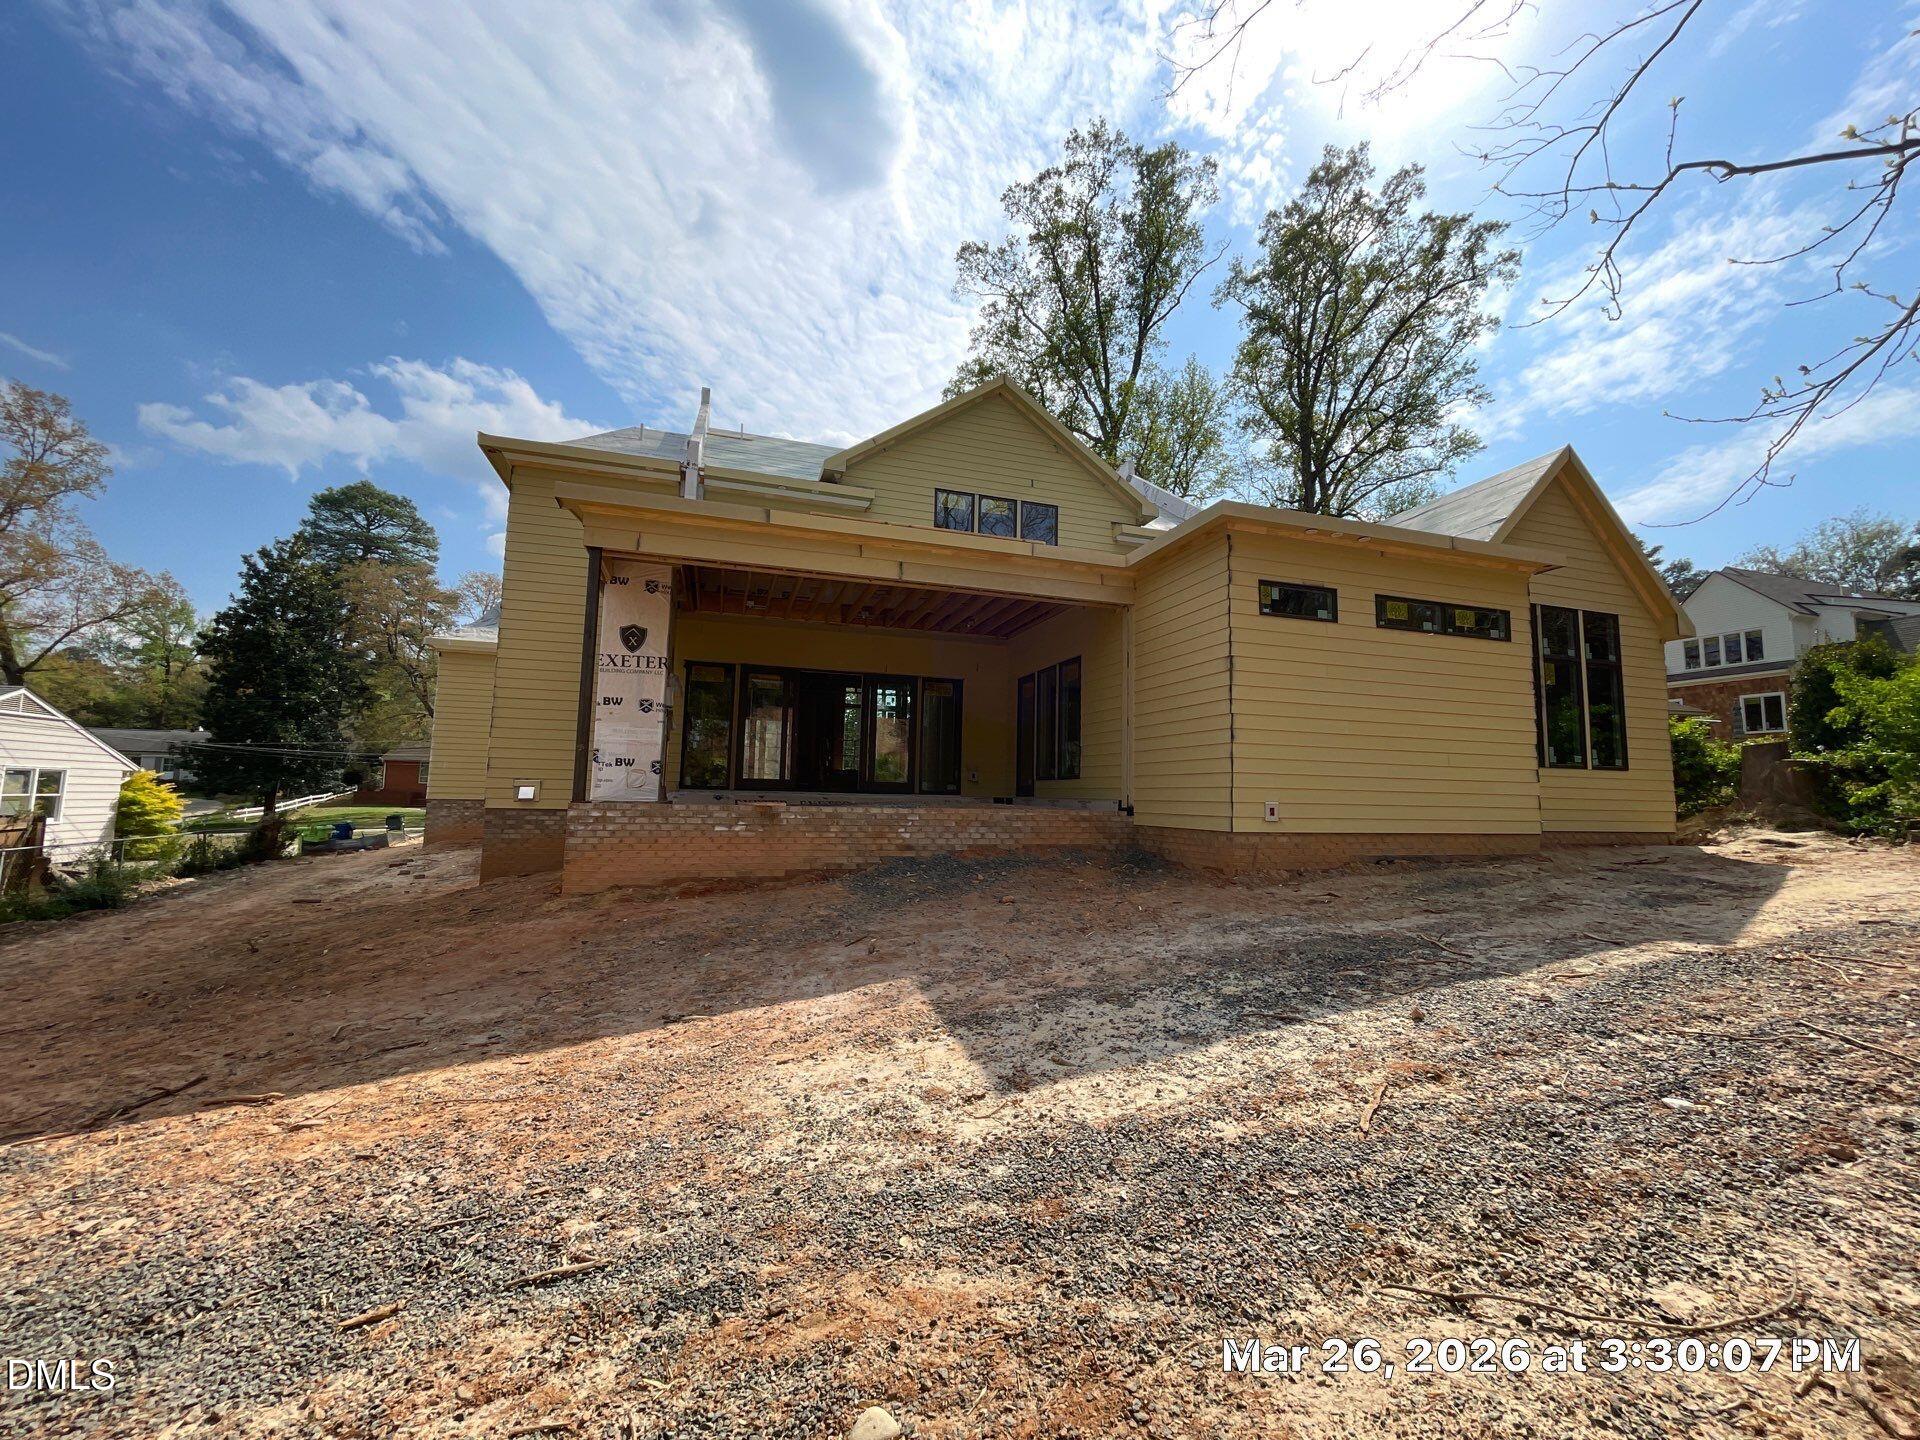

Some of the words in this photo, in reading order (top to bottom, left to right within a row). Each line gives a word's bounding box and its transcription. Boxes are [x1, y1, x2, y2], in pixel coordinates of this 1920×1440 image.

[610, 576, 630, 586] BW
[599, 653, 669, 669] EXETER
[603, 696, 623, 706] BW
[615, 758, 635, 767] BW
